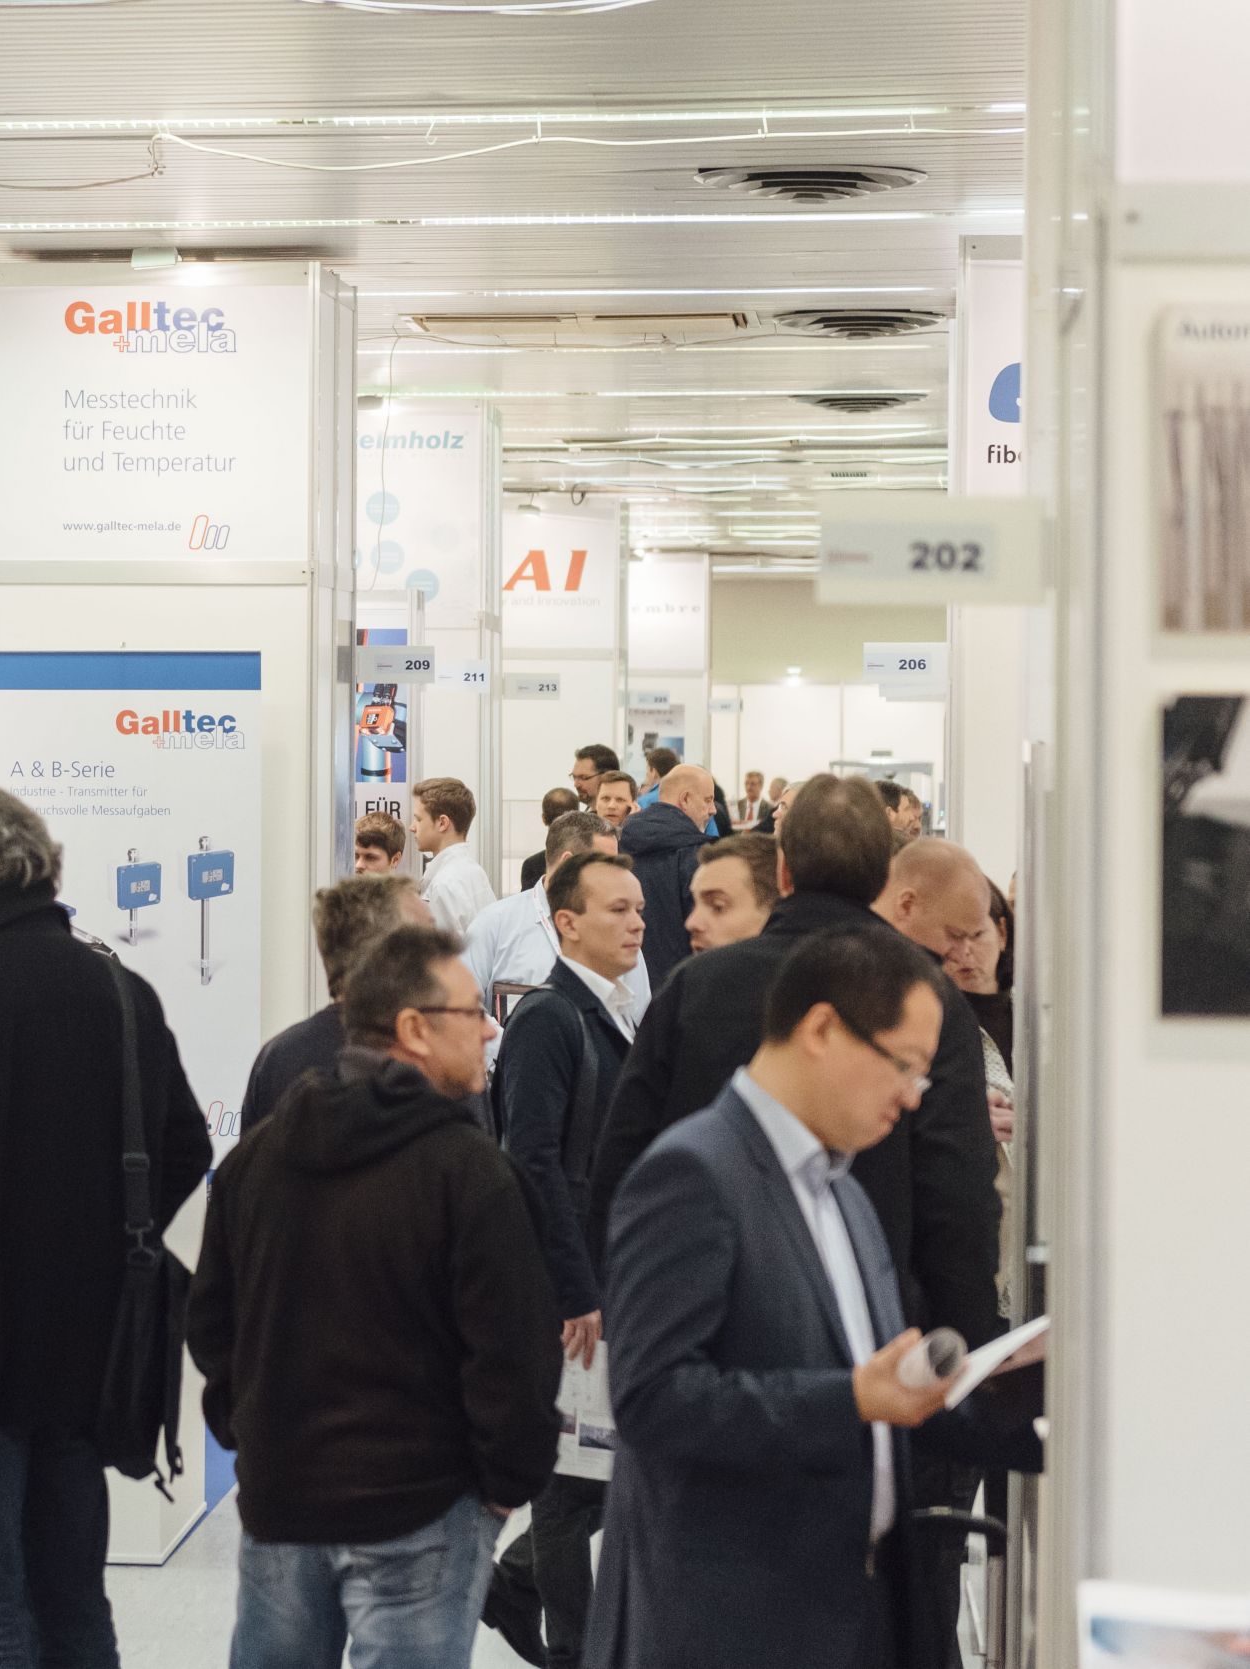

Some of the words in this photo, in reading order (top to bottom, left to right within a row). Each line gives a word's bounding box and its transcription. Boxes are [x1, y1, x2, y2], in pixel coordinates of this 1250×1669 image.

[64, 301, 225, 335] Galltec
[64, 389, 198, 409] Messtechnik
[63, 419, 94, 440] für
[102, 420, 186, 440] Feuchte
[987, 444, 1022, 464] fib
[63, 452, 104, 472] und
[111, 452, 237, 476] Temperatur
[62, 519, 182, 532] www.galltec-mela.de
[908, 541, 984, 573] 202
[405, 660, 430, 670] 209
[898, 659, 927, 670] 206
[464, 673, 485, 682] 211
[539, 684, 557, 692] 213
[115, 709, 237, 735] Galltec
[10, 761, 24, 777] A
[31, 761, 45, 777] &
[52, 761, 115, 778] B-Serie
[10, 786, 56, 797] Industrie
[68, 786, 127, 797] Transmitter
[132, 786, 148, 797] für
[31, 804, 88, 816] ruchsvolle
[92, 805, 171, 818] Messaufgaben
[365, 796, 401, 819] FÜR
